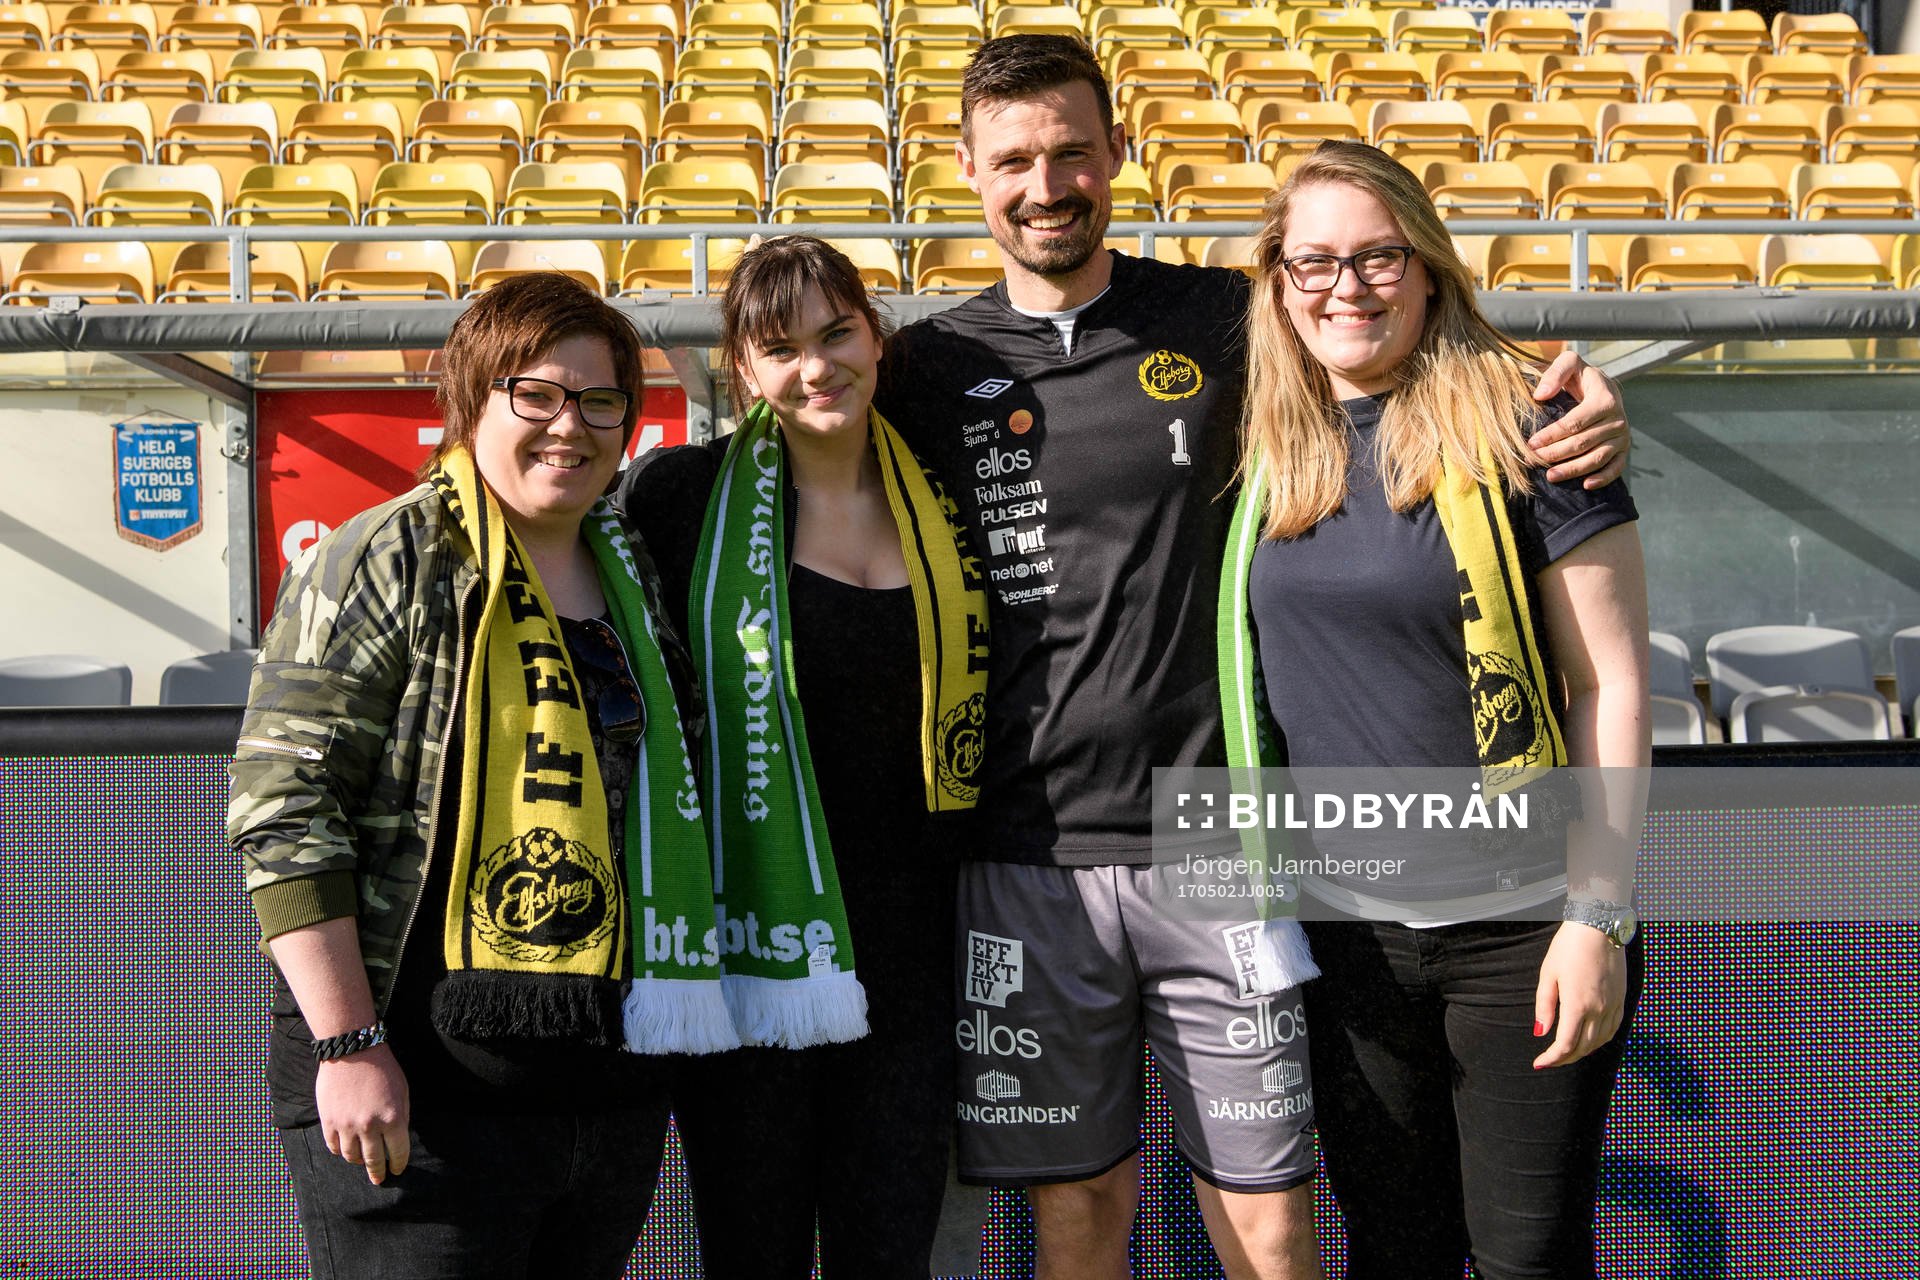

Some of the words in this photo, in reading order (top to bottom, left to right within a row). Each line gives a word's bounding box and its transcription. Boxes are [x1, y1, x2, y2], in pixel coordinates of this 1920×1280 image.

[1150, 364, 1192, 391] Elfsborg
[138, 440, 176, 454] HELA
[1168, 418, 1192, 466] 1
[122, 456, 193, 470] SVERIGES
[975, 447, 1032, 479] ellos
[121, 472, 195, 486] FOTBOLLS
[974, 479, 1043, 506] Folksam
[135, 488, 182, 502] KLUBB
[980, 499, 1047, 526] PULSEN
[1008, 584, 1057, 601] SOHLBERG
[523, 732, 583, 807] IF
[644, 907, 720, 967] bt.s
[715, 904, 838, 961] bt.se
[971, 935, 1013, 961] EFF
[971, 960, 1018, 984] EKT
[970, 980, 995, 1000] IV
[955, 1009, 1042, 1059] ellos
[1225, 1001, 1307, 1050] ellos
[956, 1101, 1078, 1124] RNGRINDEN
[1207, 1093, 1313, 1121] JÄRNGRIN
